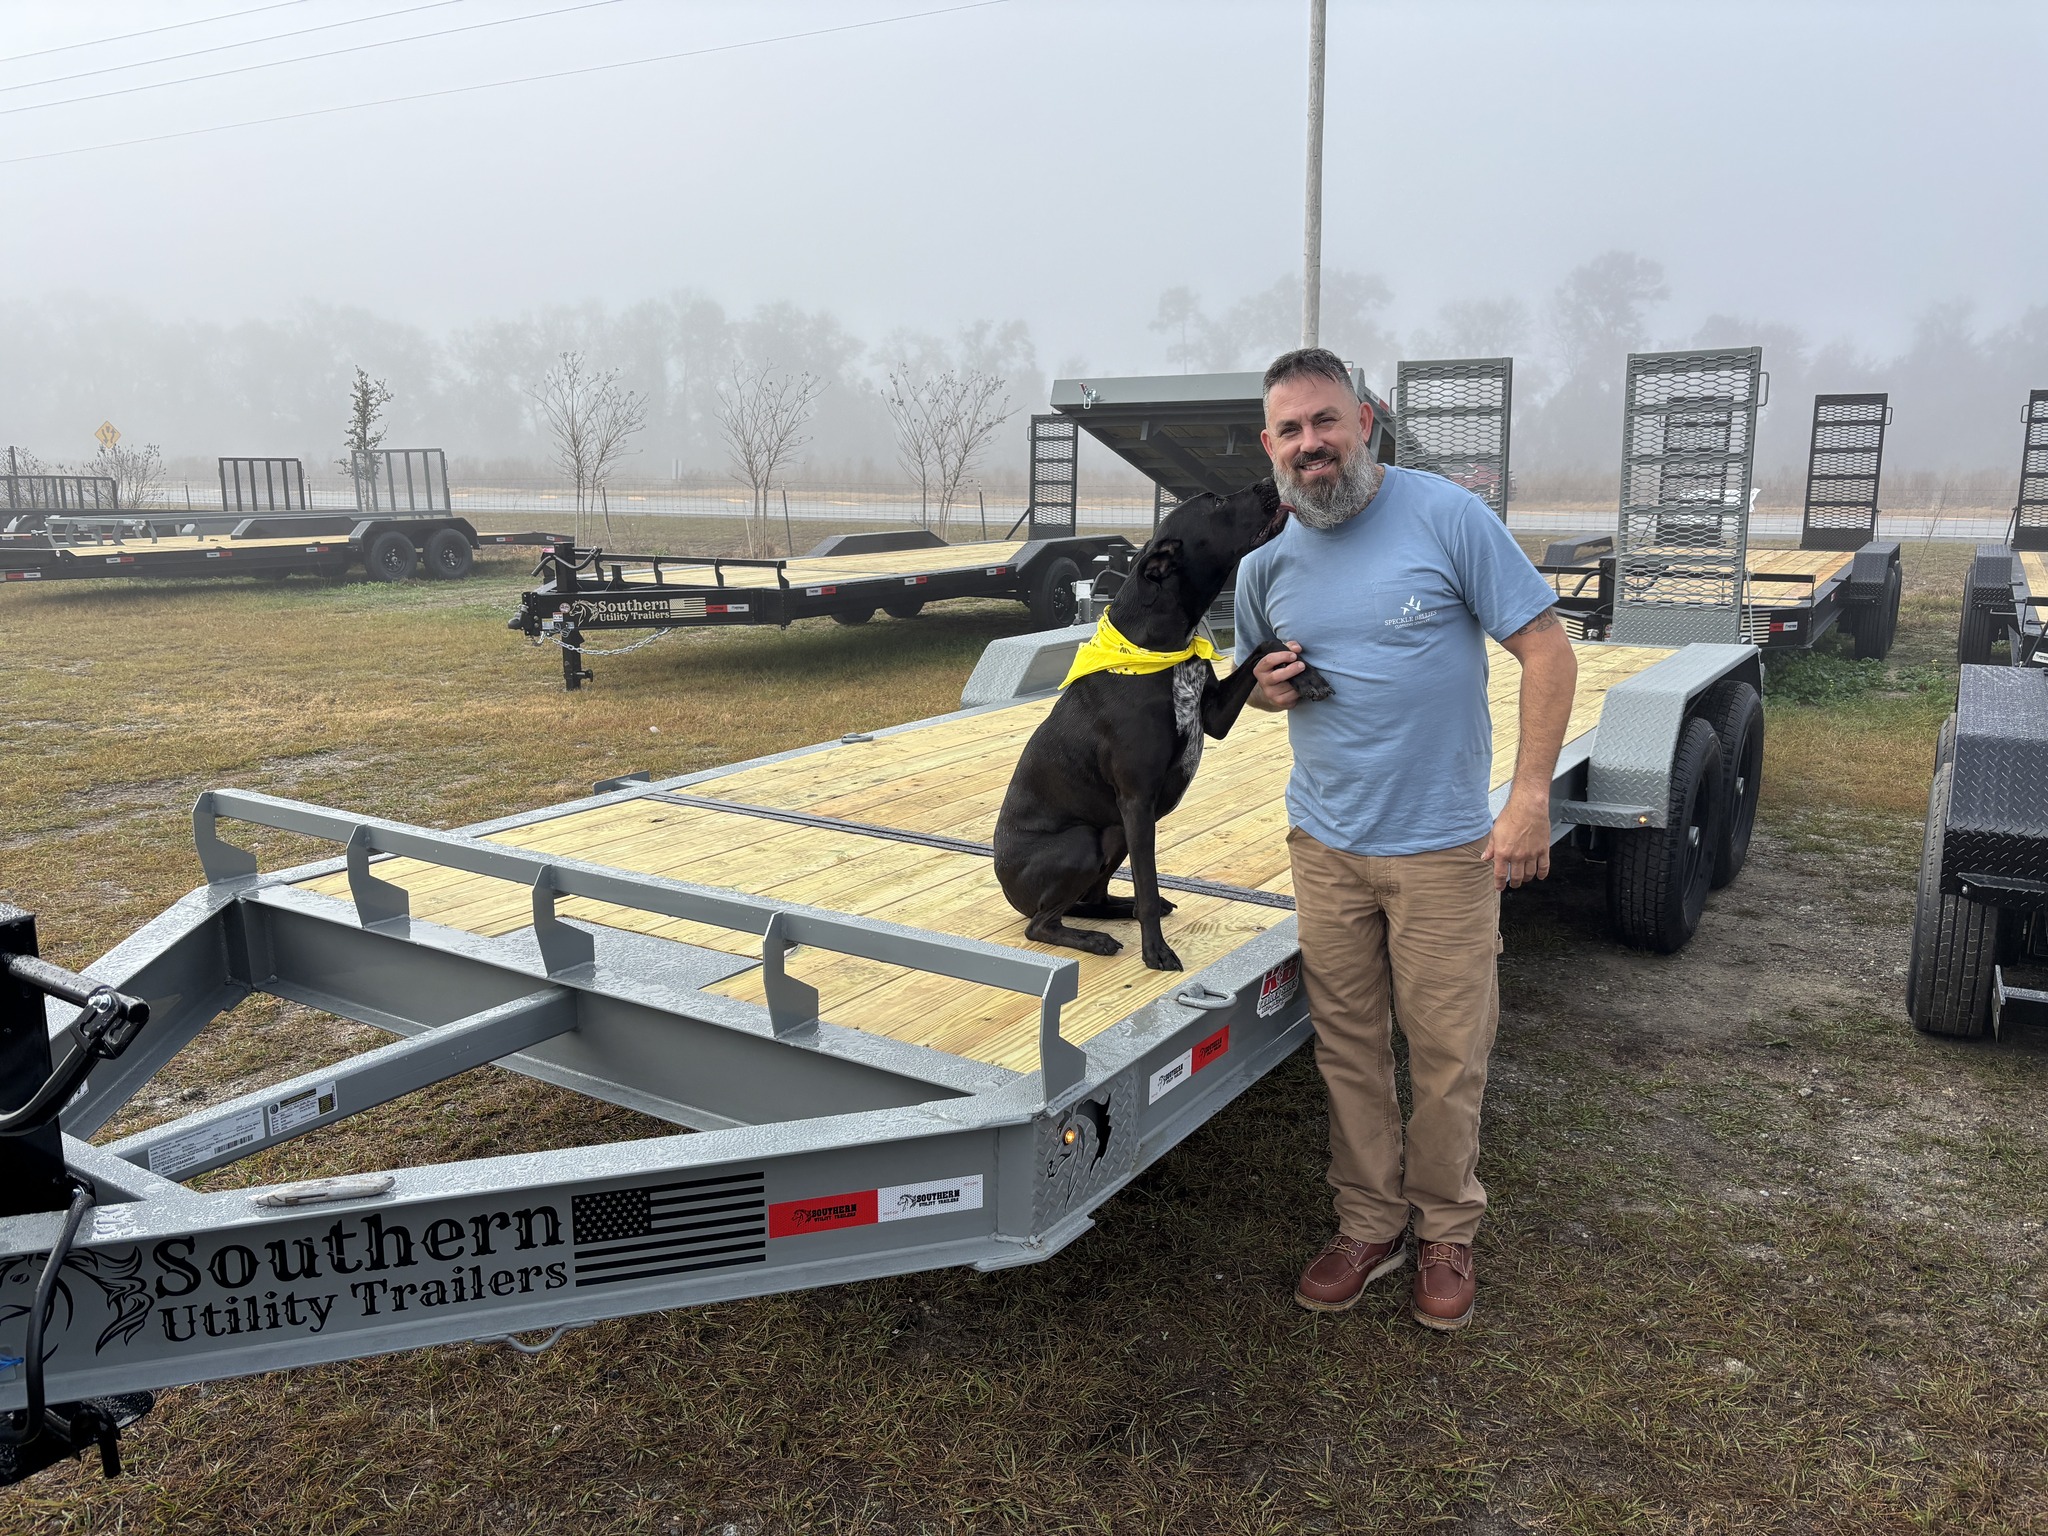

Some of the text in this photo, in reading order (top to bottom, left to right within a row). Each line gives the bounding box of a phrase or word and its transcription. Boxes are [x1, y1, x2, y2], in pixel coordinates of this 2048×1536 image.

[598, 599, 670, 613] Southern
[600, 610, 670, 622] Utility Trailers
[917, 1189, 960, 1202] SOUTHERN
[811, 1203, 857, 1218] SOUTHERN
[152, 1205, 566, 1299] Southern
[157, 1260, 569, 1343] Utility Trailers
